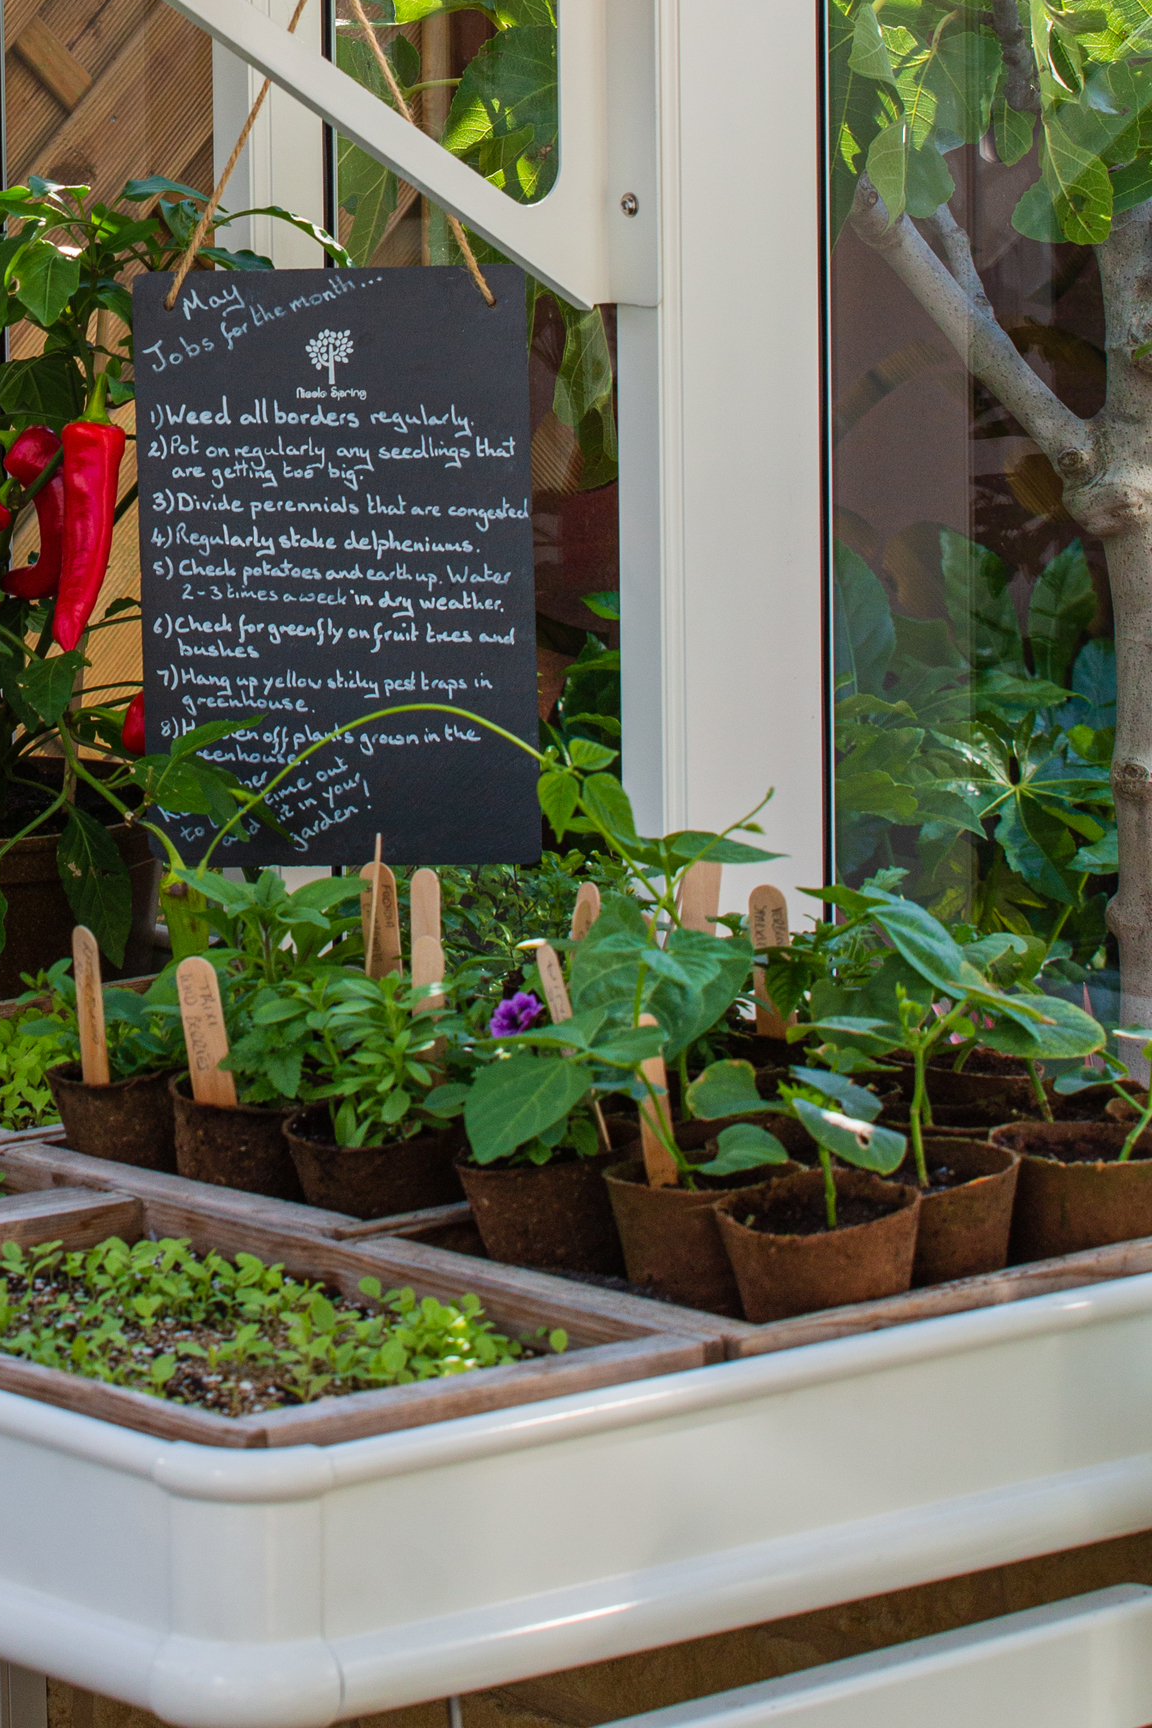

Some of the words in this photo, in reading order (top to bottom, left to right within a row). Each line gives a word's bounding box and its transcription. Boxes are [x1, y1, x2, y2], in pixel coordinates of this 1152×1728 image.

[182, 285, 245, 321] May
[142, 337, 215, 372] Jobs
[221, 320, 248, 351] for
[251, 303, 285, 327] the
[330, 385, 368, 402] Spring
[165, 395, 232, 426] Weed
[239, 397, 269, 426] all
[273, 399, 360, 429] borders
[370, 403, 474, 439] regularly.
[170, 434, 200, 456] Pot
[205, 446, 231, 458] on
[234, 435, 326, 471] regularly
[336, 447, 375, 472] any
[378, 434, 471, 469] seedlings
[475, 435, 516, 458] that
[171, 466, 206, 479] are
[211, 459, 279, 490] getting
[282, 461, 315, 480] too
[328, 461, 364, 492] big.
[176, 492, 245, 513] Divide
[249, 495, 360, 520] perennials
[366, 493, 407, 516] that
[411, 505, 442, 517] are
[448, 497, 529, 532] congested
[176, 522, 276, 558] Regularly
[278, 526, 337, 550] stake
[343, 529, 481, 561] delpheniums.
[178, 557, 237, 577] Check
[241, 558, 323, 589] potatoes
[325, 563, 364, 581] and
[366, 562, 413, 581] earth
[415, 572, 443, 592] up.
[446, 563, 512, 584] Water
[227, 584, 279, 602] times
[298, 588, 347, 606] week
[349, 589, 374, 607] in
[378, 590, 415, 619] dry
[419, 590, 505, 613] weather.
[174, 613, 233, 634] Check
[238, 614, 265, 644] for
[267, 617, 344, 646] greenfly
[347, 628, 371, 639] on
[370, 622, 420, 654] fruit
[426, 622, 473, 644] trees
[479, 627, 515, 646] and
[177, 638, 260, 659] bushes
[181, 667, 233, 696] Hang
[236, 676, 259, 697] up
[262, 669, 322, 696] yellow
[327, 669, 380, 699] sticky
[383, 671, 416, 697] pest
[421, 671, 468, 700] traps
[474, 672, 493, 690] in
[182, 688, 316, 716] greenhouse.
[181, 717, 259, 742] Hen
[262, 726, 289, 755] off
[359, 733, 420, 756] grown
[424, 727, 441, 744] in
[444, 723, 482, 742] the
[196, 745, 309, 766] reenhouse.
[179, 825, 206, 843] to
[315, 756, 350, 784] out
[222, 818, 261, 847] ad
[297, 797, 318, 811] in
[322, 771, 361, 809] your
